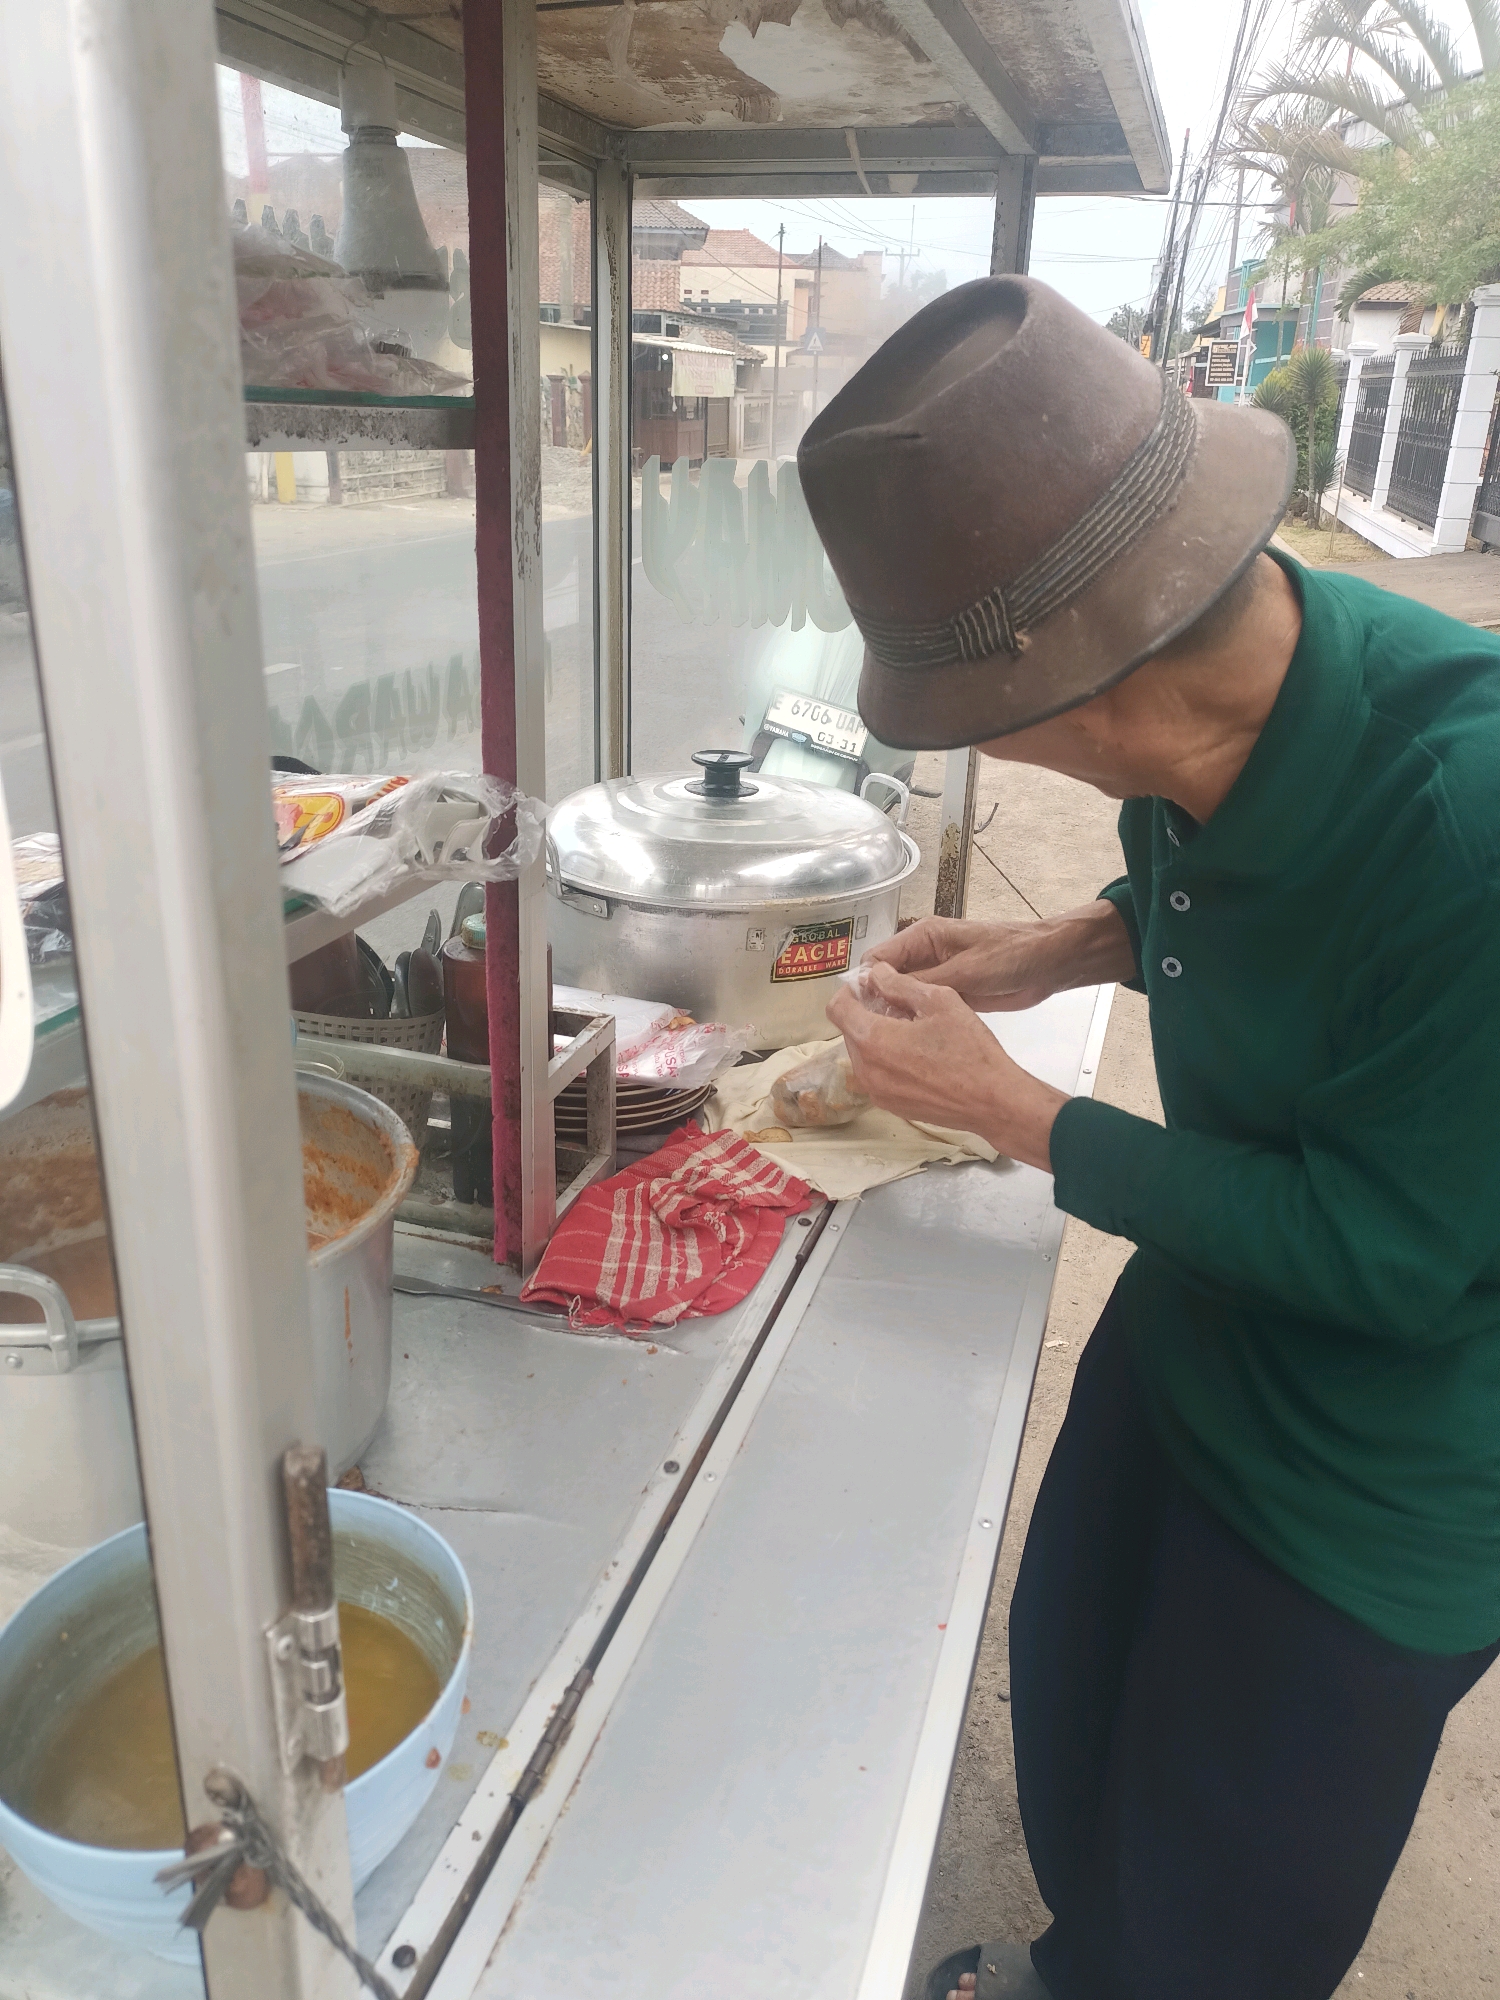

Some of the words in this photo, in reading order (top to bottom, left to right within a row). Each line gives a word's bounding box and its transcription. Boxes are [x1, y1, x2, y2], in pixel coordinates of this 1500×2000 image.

[791, 699, 829, 725] 6706
[793, 928, 840, 943] GLOBAL
[781, 940, 846, 964] EAGLE
[778, 964, 817, 975] DURABLE
[825, 958, 846, 969] WARE
